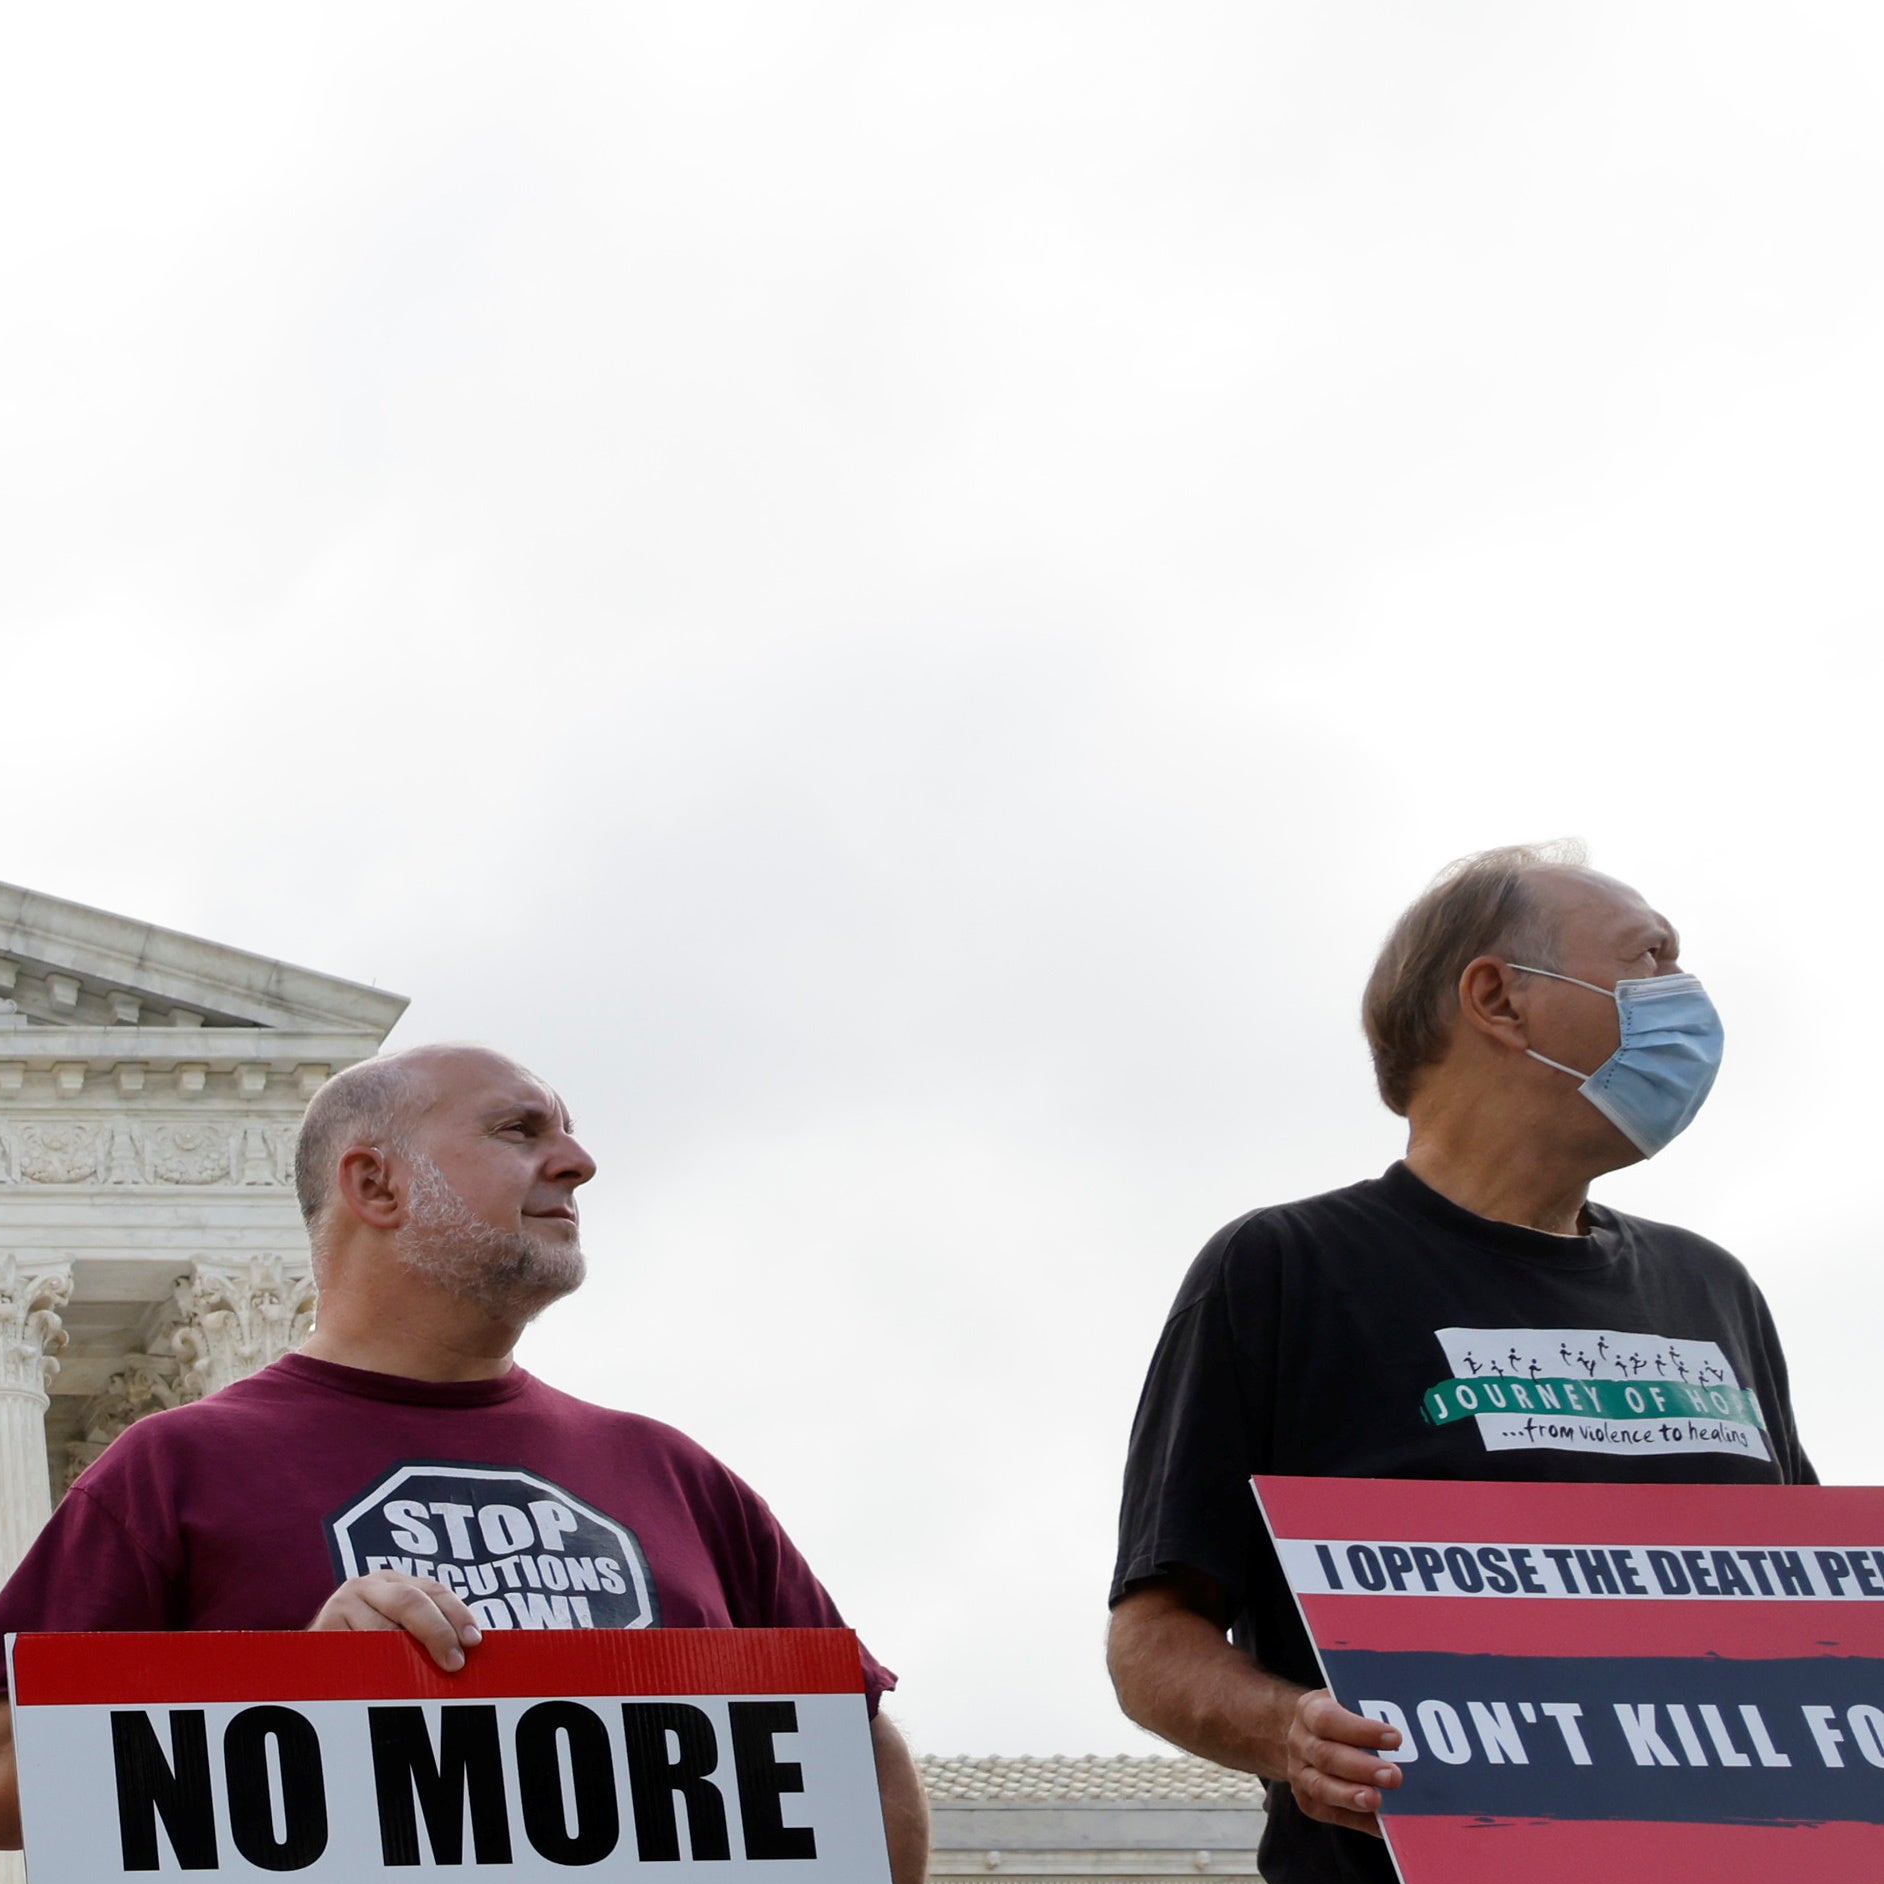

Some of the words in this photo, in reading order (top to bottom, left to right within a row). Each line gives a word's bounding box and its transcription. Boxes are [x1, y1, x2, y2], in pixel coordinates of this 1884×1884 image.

[1434, 1383, 1602, 1421] JOURNEY
[1625, 1386, 1669, 1414] OF
[1581, 1421, 1655, 1443] violence
[1658, 1421, 1682, 1442] to
[1688, 1420, 1748, 1447] healing
[383, 1500, 579, 1560] STOP
[1316, 1544, 1342, 1590] I
[1345, 1543, 1548, 1594] OPPOSE
[1540, 1548, 1642, 1596] THE
[1645, 1549, 1816, 1597] DEATH
[1813, 1550, 1884, 1597] PE
[1358, 1699, 1593, 1765] DON'T
[1612, 1703, 1793, 1768] KILL
[109, 1703, 330, 1873] NO
[367, 1699, 818, 1868] MORE
